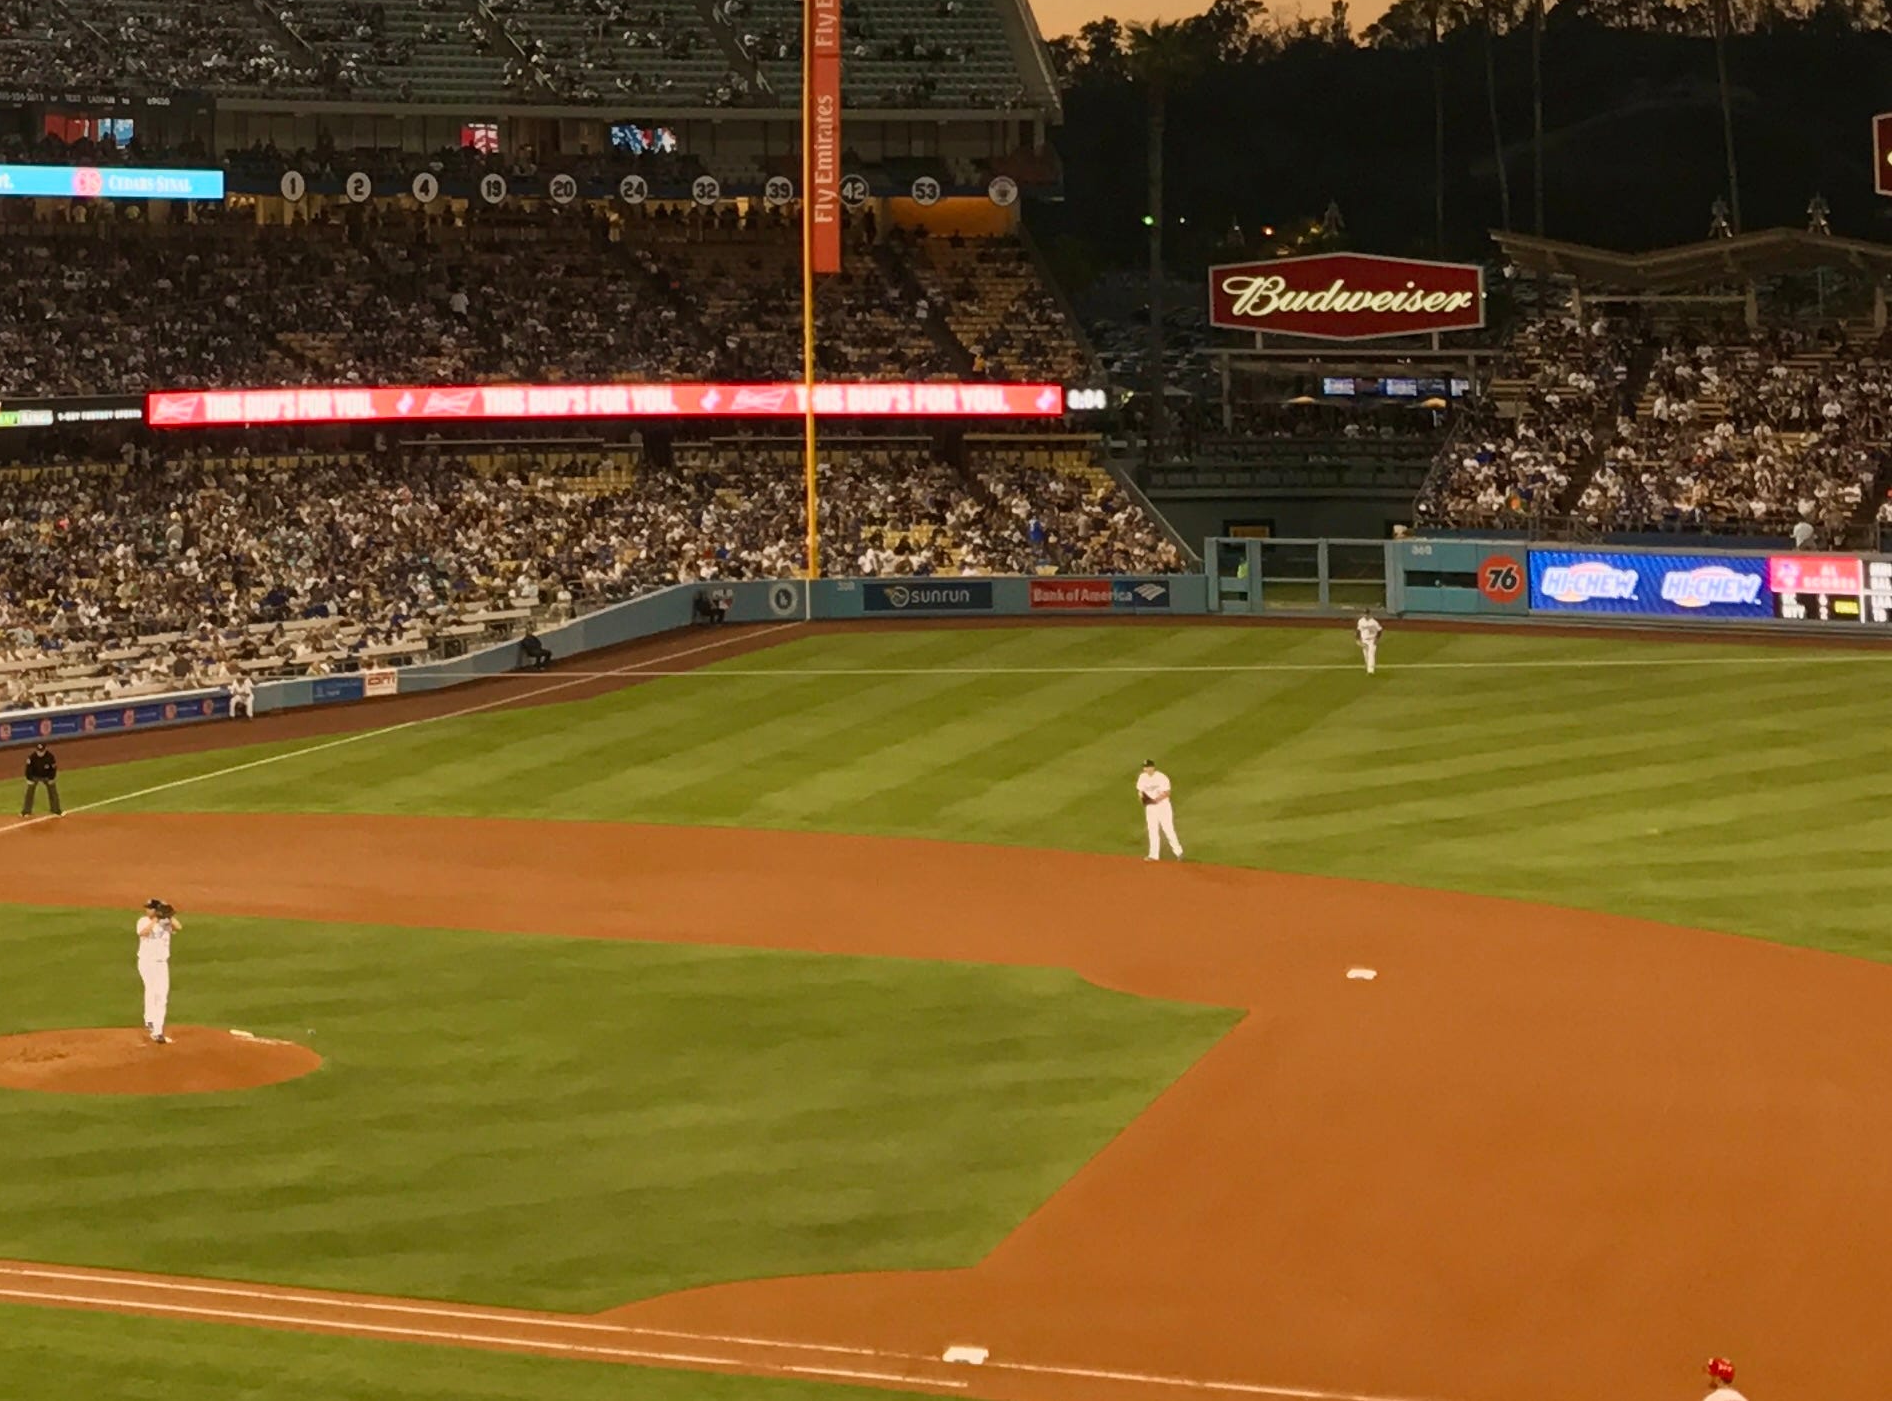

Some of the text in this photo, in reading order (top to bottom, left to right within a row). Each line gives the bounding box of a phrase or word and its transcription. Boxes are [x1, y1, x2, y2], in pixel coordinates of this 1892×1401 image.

[814, 12, 838, 47] Fly
[813, 94, 838, 224] Fly Emirates
[289, 177, 296, 196] 1
[353, 178, 364, 197] 2
[419, 179, 431, 197] 4
[485, 180, 501, 197] 19
[554, 180, 573, 197] 20
[622, 181, 645, 198] 24
[694, 182, 718, 199] 32
[768, 182, 791, 199] 39
[842, 182, 866, 200] 42
[914, 182, 938, 200] 53
[1221, 275, 1472, 317] Budweiser
[296, 391, 333, 418] FOR
[482, 388, 525, 414] THIS
[588, 388, 629, 413] FOR
[846, 387, 912, 411] BUD'S
[913, 387, 957, 411] FOR
[1485, 565, 1520, 593] 76
[1543, 568, 1638, 597] HI-CHEW
[1664, 572, 1761, 601] HI-CHEW
[911, 590, 970, 604] sunrun
[1033, 588, 1133, 603] Bank of America
